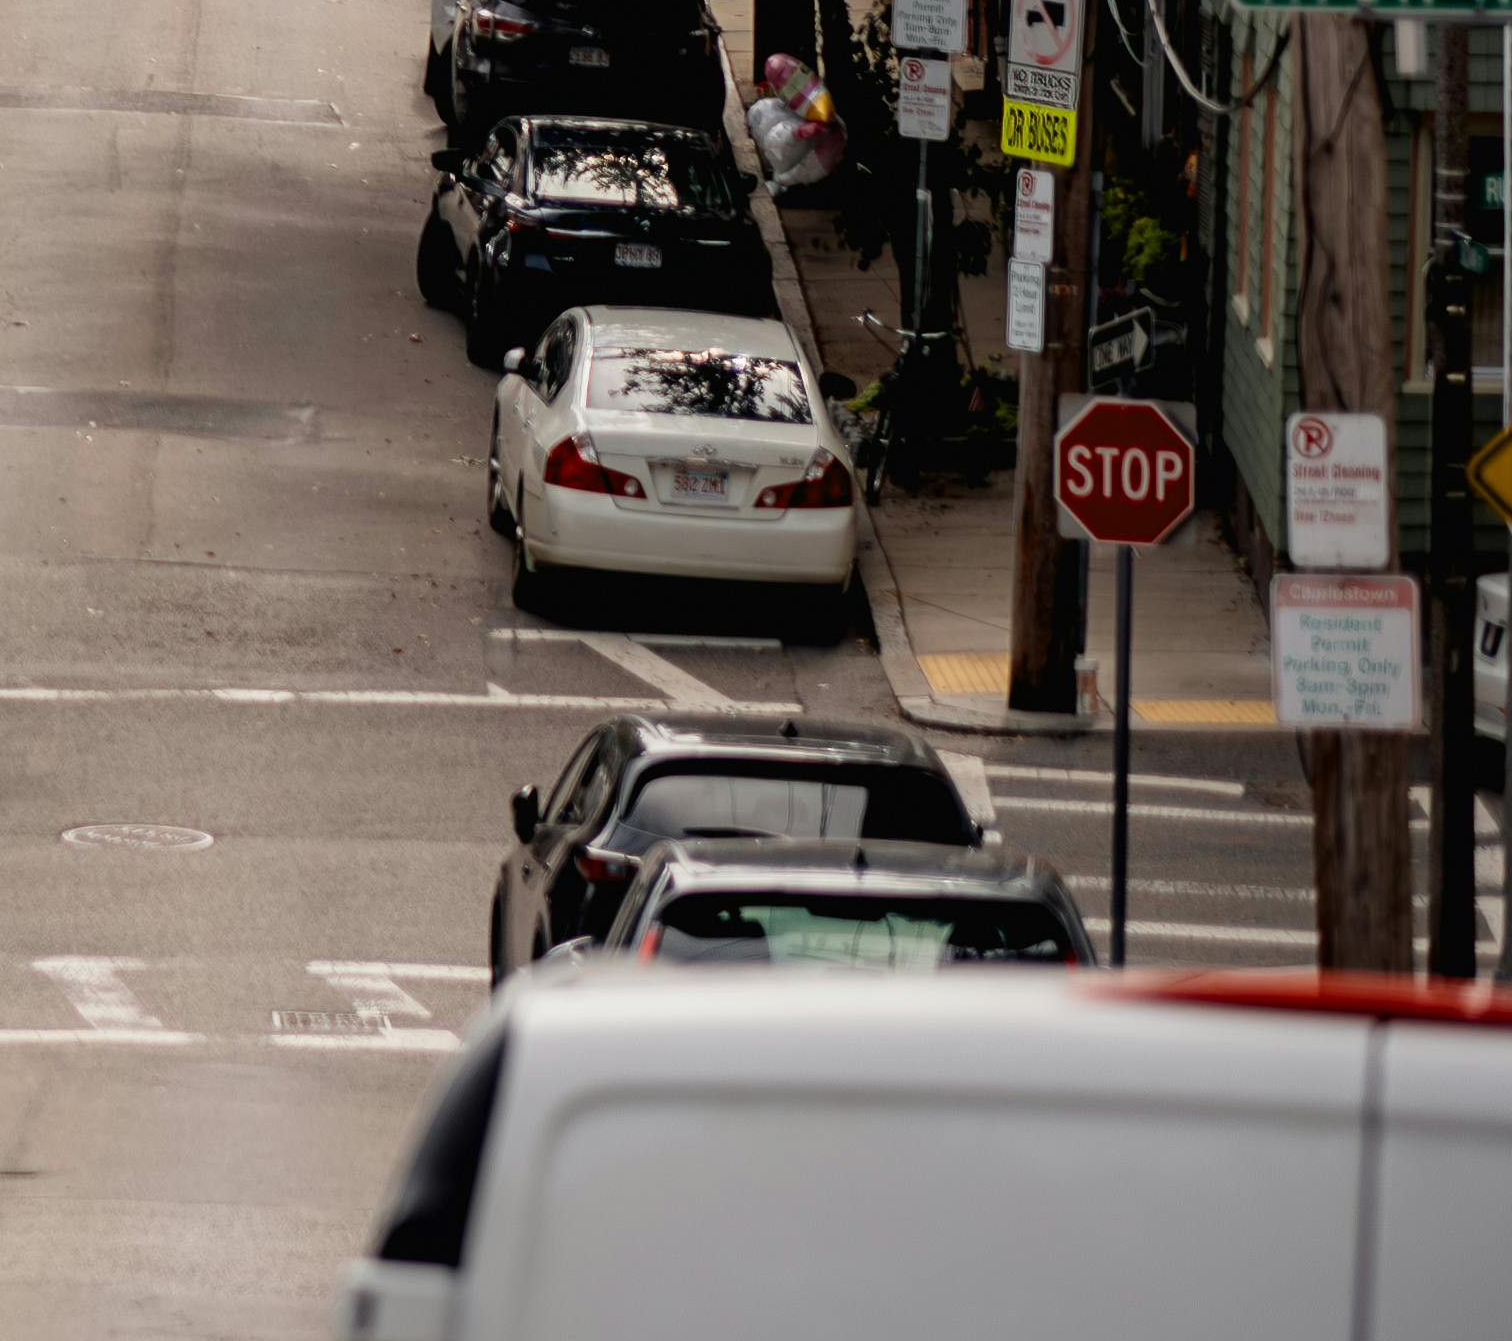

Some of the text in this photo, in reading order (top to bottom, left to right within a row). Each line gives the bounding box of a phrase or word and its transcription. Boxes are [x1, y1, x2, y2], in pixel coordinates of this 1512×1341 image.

[1030, 70, 1072, 91] TRUCKS
[1007, 108, 1069, 157] OR BUSES
[1067, 445, 1183, 501] STOP
[1293, 462, 1381, 484] Street Cleaning
[1289, 583, 1397, 601] Charlestown
[1300, 615, 1383, 632] Resident
[1311, 636, 1370, 652] Permit
[1283, 655, 1402, 677] Parking Only
